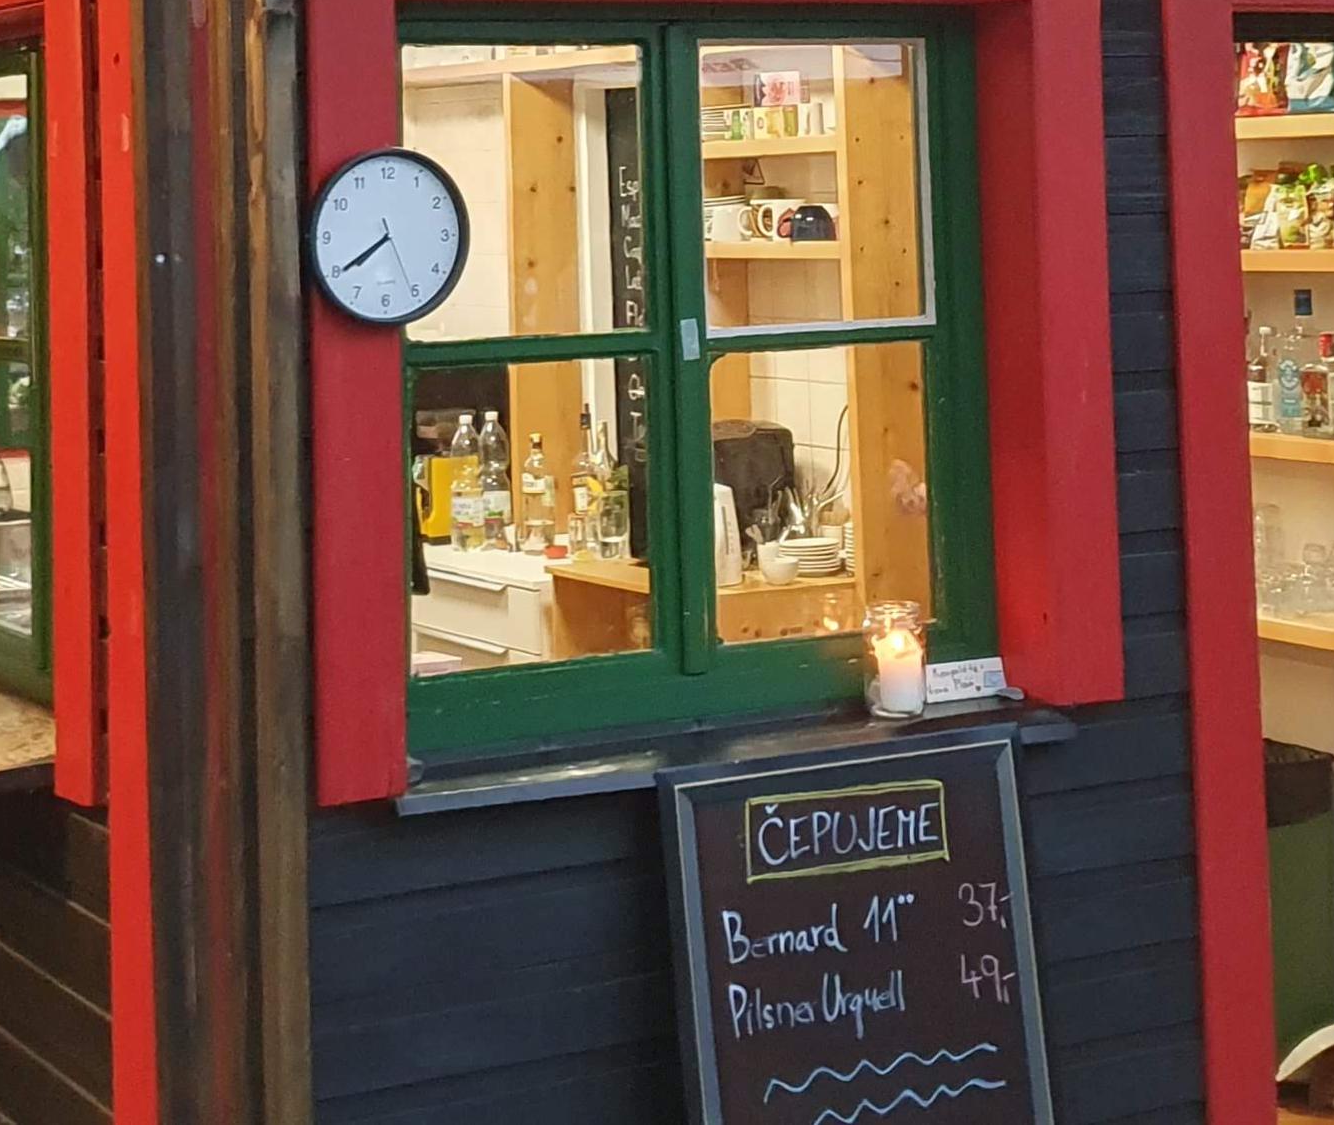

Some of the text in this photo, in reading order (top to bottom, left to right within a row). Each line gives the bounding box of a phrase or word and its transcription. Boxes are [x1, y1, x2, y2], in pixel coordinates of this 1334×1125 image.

[381, 166, 395, 180] 12
[354, 176, 365, 189] 11
[414, 176, 420, 188] 1
[333, 197, 348, 211] 10
[432, 196, 441, 209] 2
[322, 231, 331, 244] 9
[440, 229, 449, 242] 3
[331, 265, 341, 278] 8
[431, 262, 440, 275] 4
[353, 286, 362, 299] 7
[381, 294, 390, 307] 6
[757, 802, 940, 866] ČEPUJEME
[722, 902, 849, 965] Bernard
